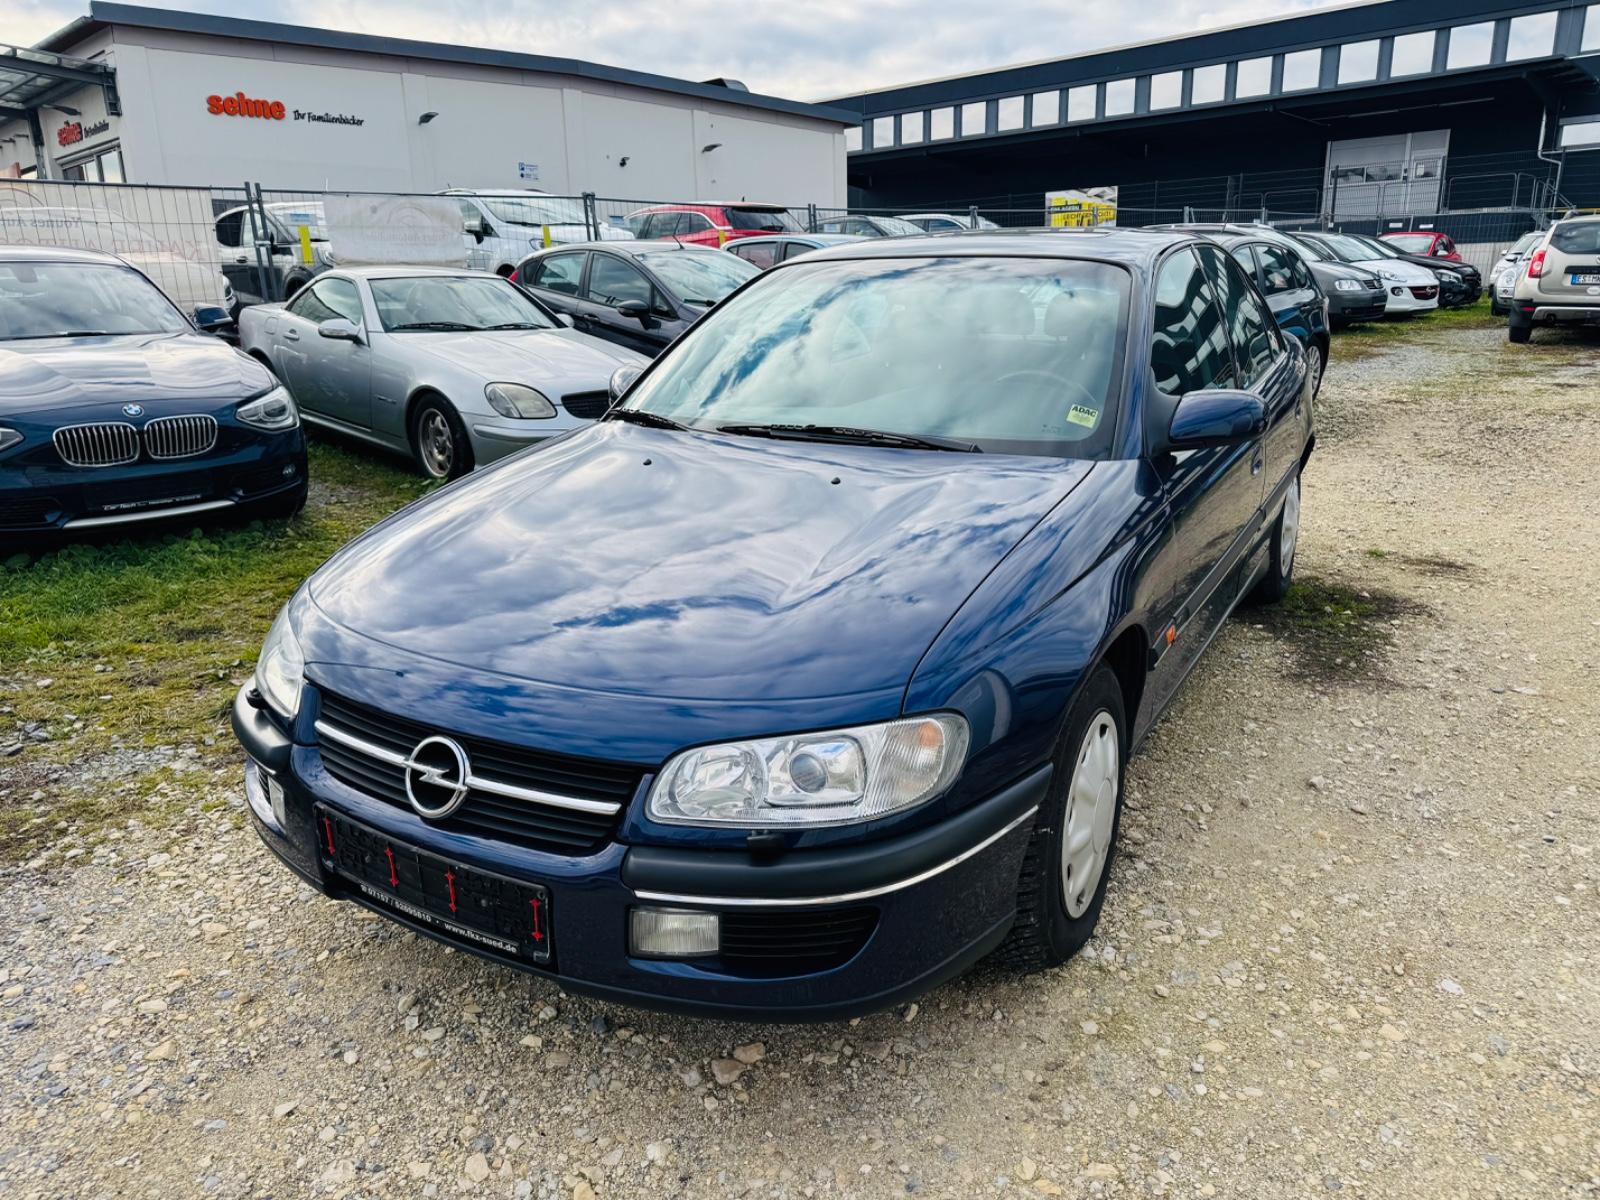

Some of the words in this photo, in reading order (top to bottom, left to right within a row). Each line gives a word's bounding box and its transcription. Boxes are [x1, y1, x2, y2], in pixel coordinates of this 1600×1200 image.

[206, 91, 286, 121] sehne
[293, 109, 305, 121] Ihr
[1072, 405, 1097, 417] ADAC
